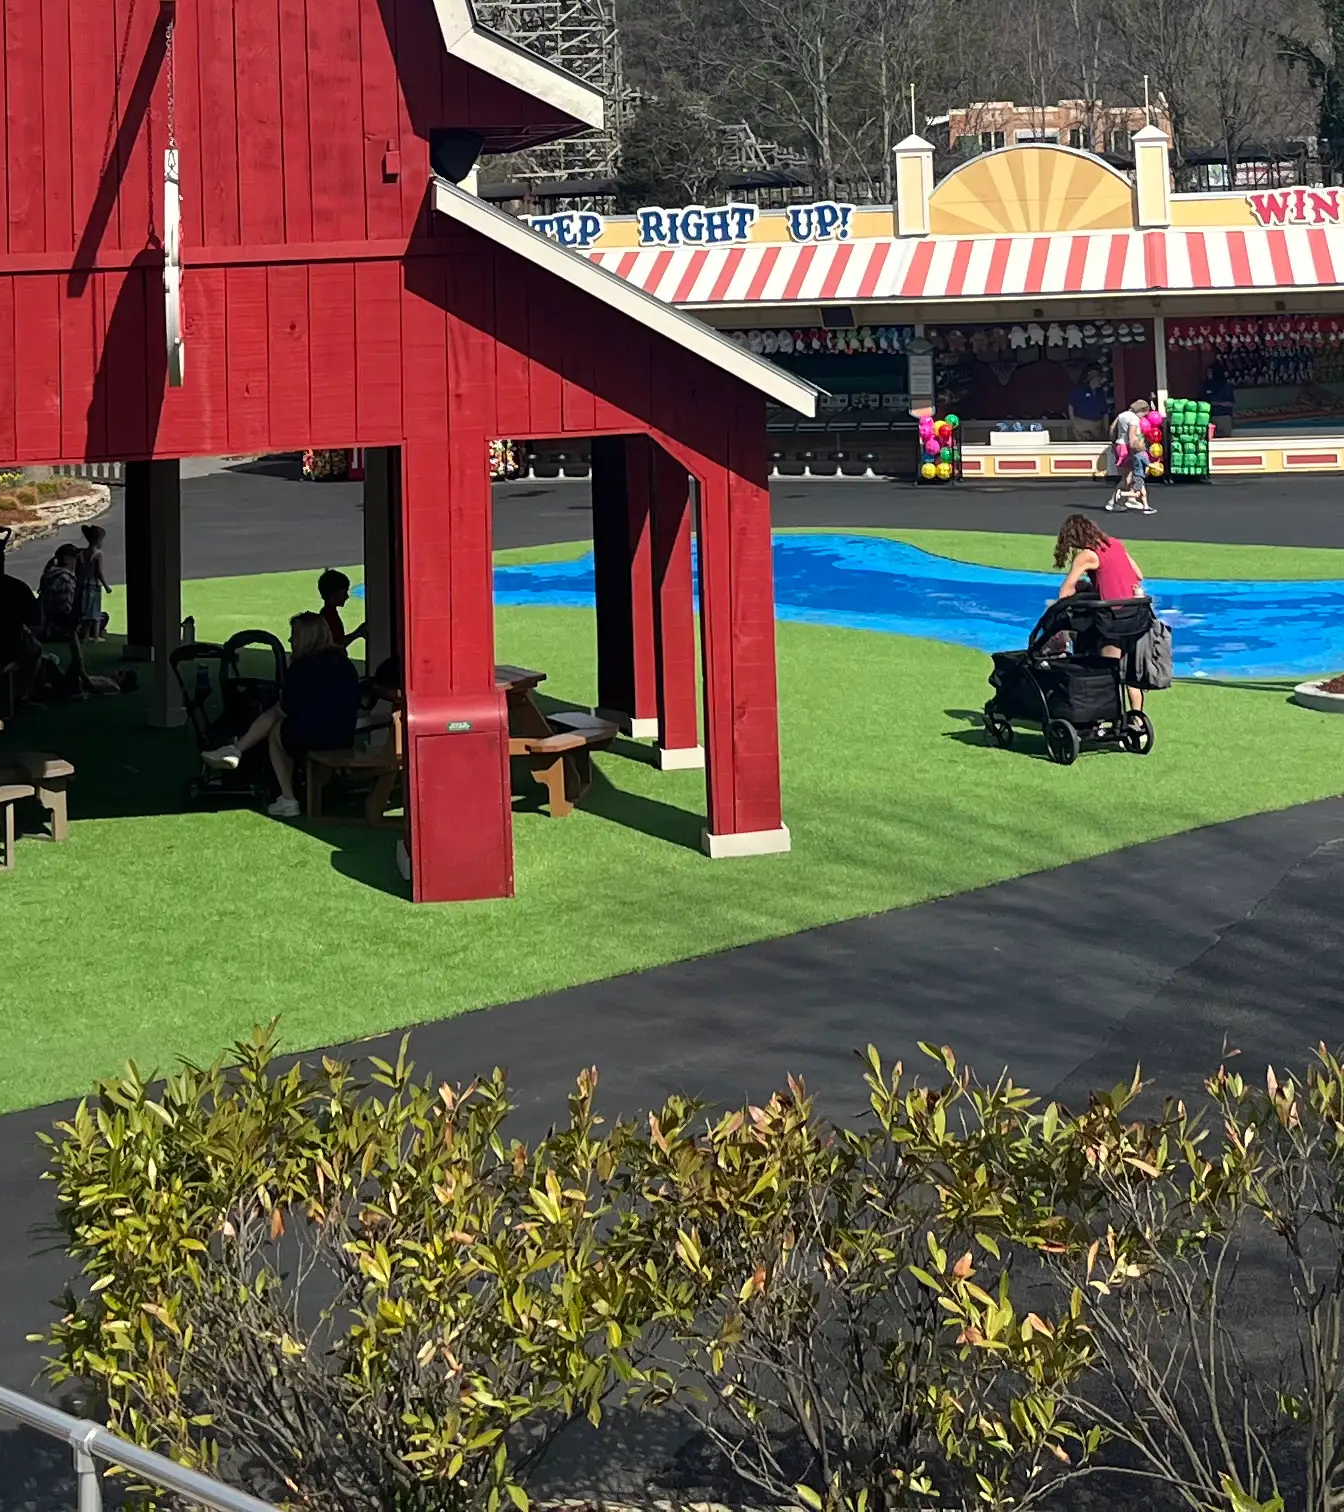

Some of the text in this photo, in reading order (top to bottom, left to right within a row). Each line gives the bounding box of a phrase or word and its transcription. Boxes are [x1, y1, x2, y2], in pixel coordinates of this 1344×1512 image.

[530, 204, 851, 246] TEP RIGHT UP!
[1249, 190, 1340, 224] WIN
